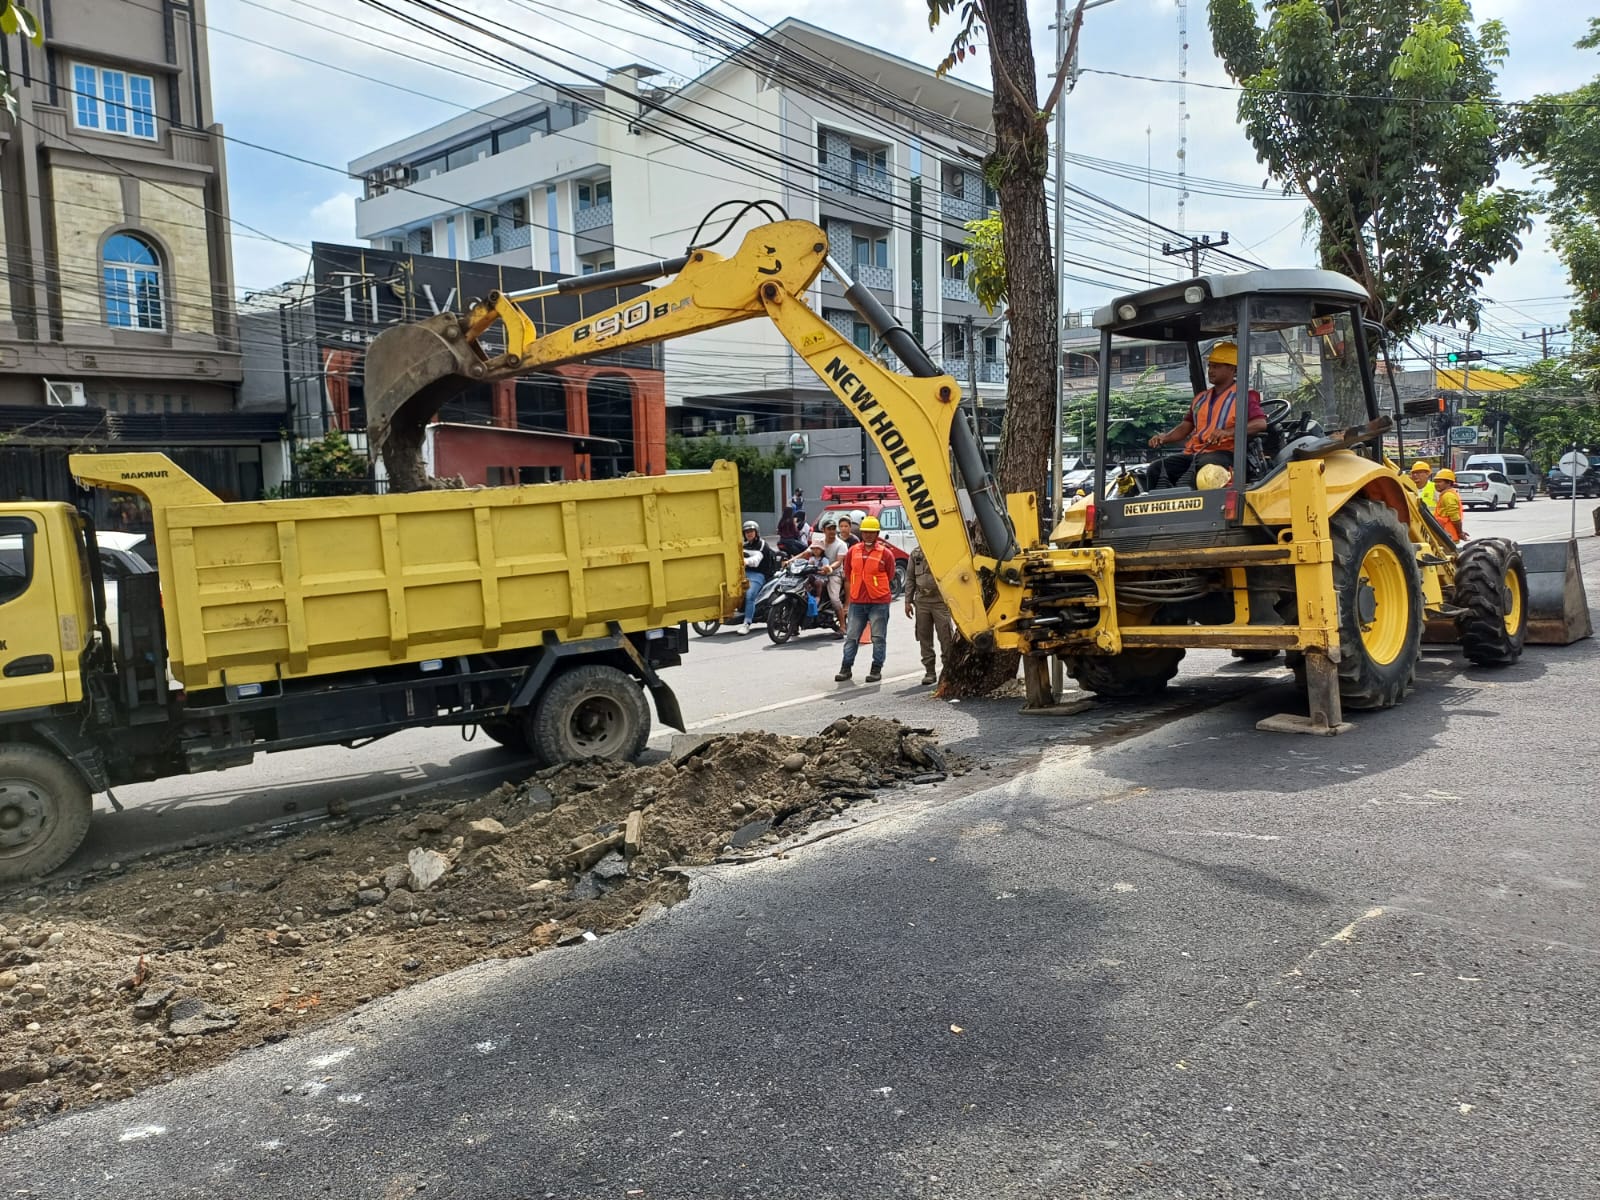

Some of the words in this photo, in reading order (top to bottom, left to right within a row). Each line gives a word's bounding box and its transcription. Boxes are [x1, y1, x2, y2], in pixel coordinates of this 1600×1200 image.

[823, 356, 879, 414] NEW
[868, 410, 940, 530] HOLLAND
[121, 470, 169, 480] MAKMUR
[1125, 504, 1149, 515] NEW
[1151, 499, 1201, 512] HOLLAND
